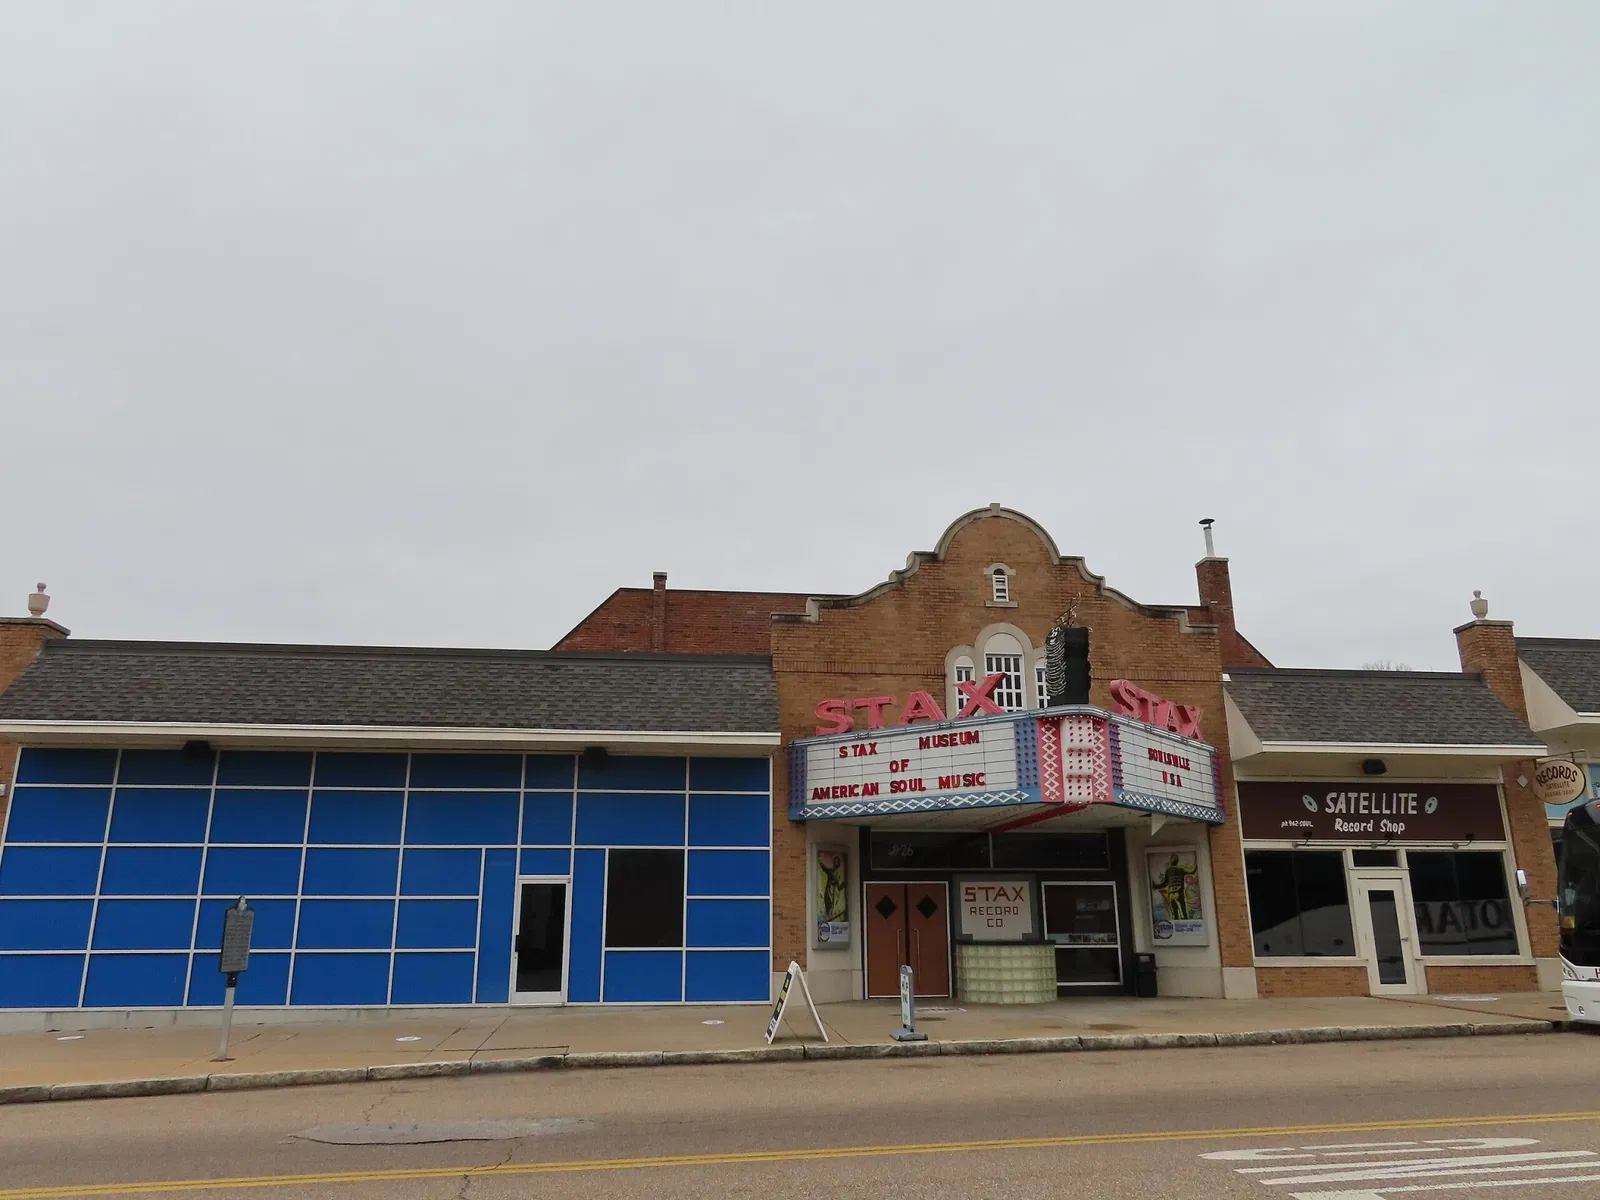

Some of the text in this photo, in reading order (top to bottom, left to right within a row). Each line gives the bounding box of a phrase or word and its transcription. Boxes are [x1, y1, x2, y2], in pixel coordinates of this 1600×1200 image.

[815, 672, 1008, 737] STAX
[1110, 679, 1208, 743] STAX
[839, 730, 979, 758] STAX MUSEUM
[889, 759, 909, 773] OF
[1148, 748, 1190, 771] SOULSVILLE
[812, 772, 986, 800] AMERICAN SOUL MUSIC
[1536, 765, 1577, 787] RECORDS
[1324, 792, 1418, 814] SATELLITE
[1334, 818, 1405, 834] Record Shop
[964, 886, 1024, 902] STAX
[969, 906, 1018, 916] RECORD
[987, 918, 1005, 928] CO.
